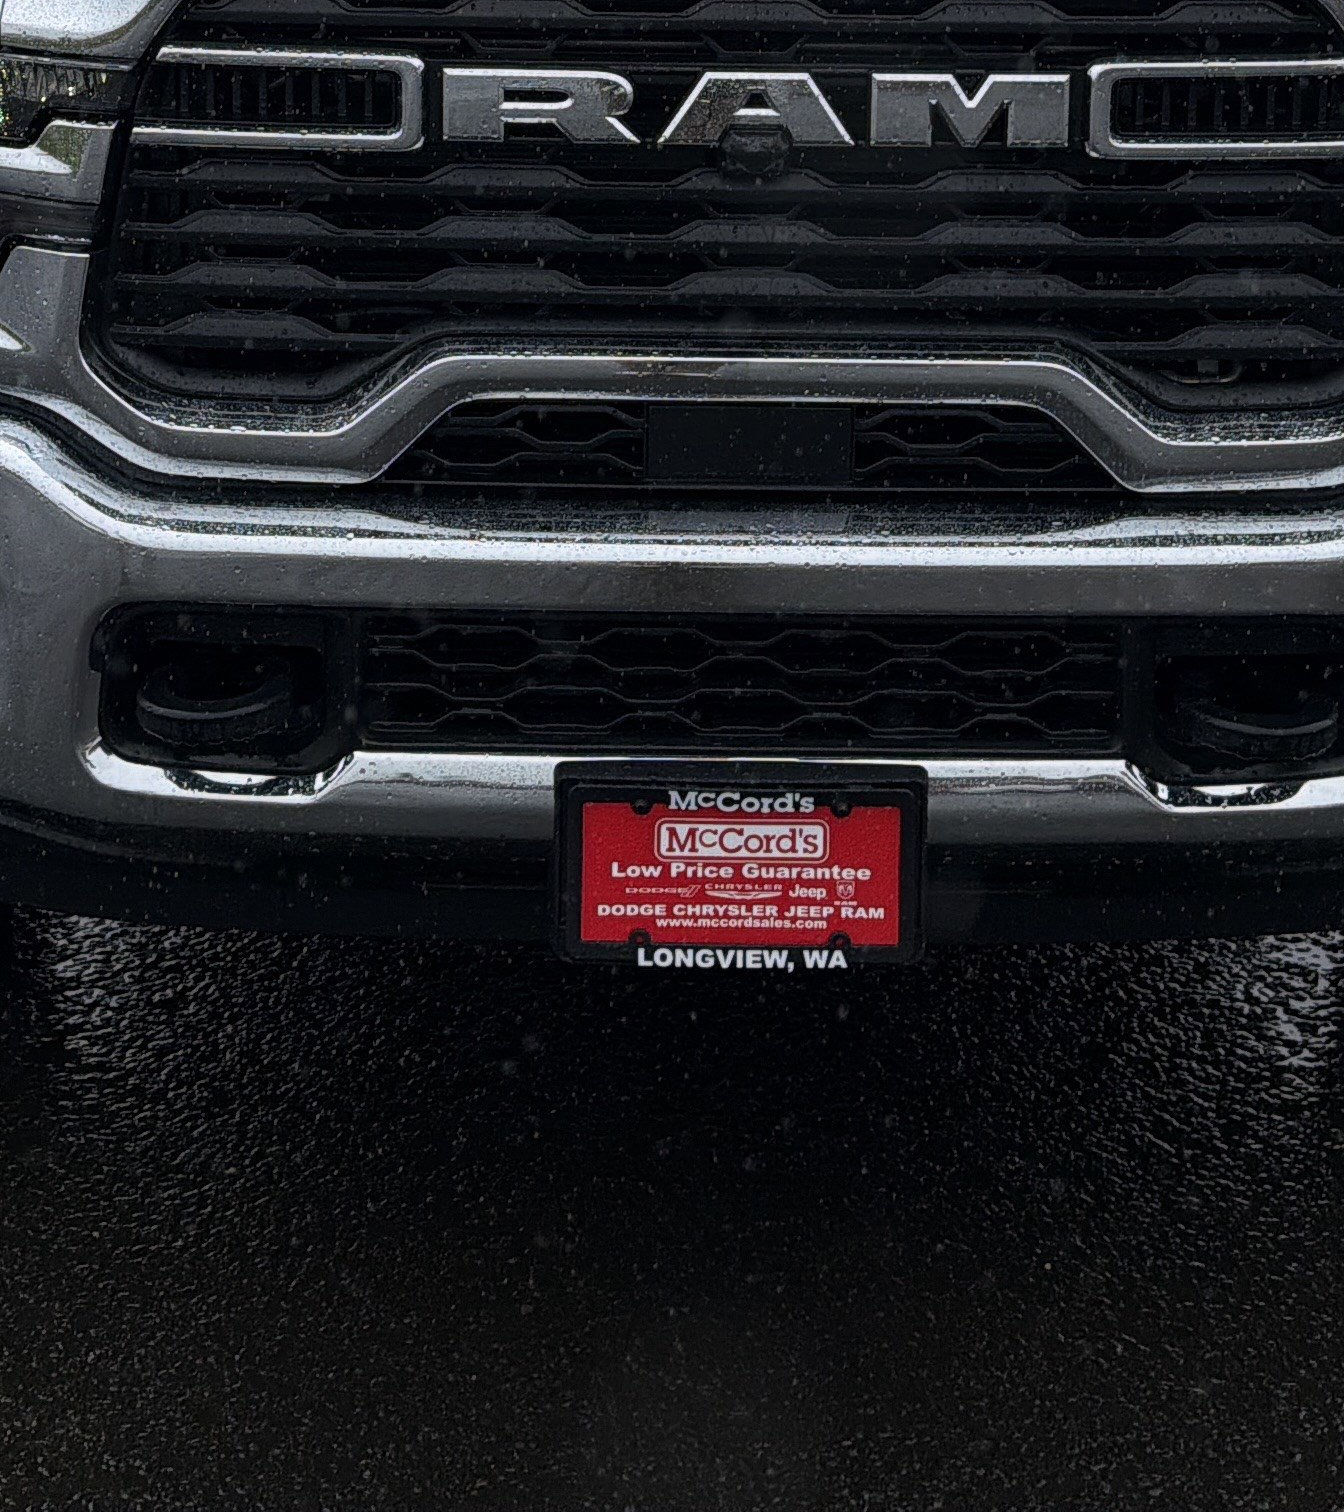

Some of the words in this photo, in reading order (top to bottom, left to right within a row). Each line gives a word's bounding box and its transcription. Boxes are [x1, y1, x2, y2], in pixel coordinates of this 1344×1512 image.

[442, 67, 1071, 148] RAM
[668, 790, 815, 814] McCord's
[665, 826, 819, 855] McCord's
[611, 862, 662, 878] Low
[670, 862, 734, 879] Price
[742, 864, 872, 881] Guarantee
[625, 886, 688, 894] DODGE
[704, 883, 783, 891] CHRYSLER
[788, 885, 827, 900] Jeep
[597, 903, 667, 917] DODGE
[673, 904, 778, 918] CHRYSLER
[784, 906, 834, 919] JEEP
[841, 906, 885, 920] RAM
[656, 917, 827, 930] www.mccordsales.com
[637, 948, 795, 973] LONGVIEW,
[803, 950, 848, 969] WA
